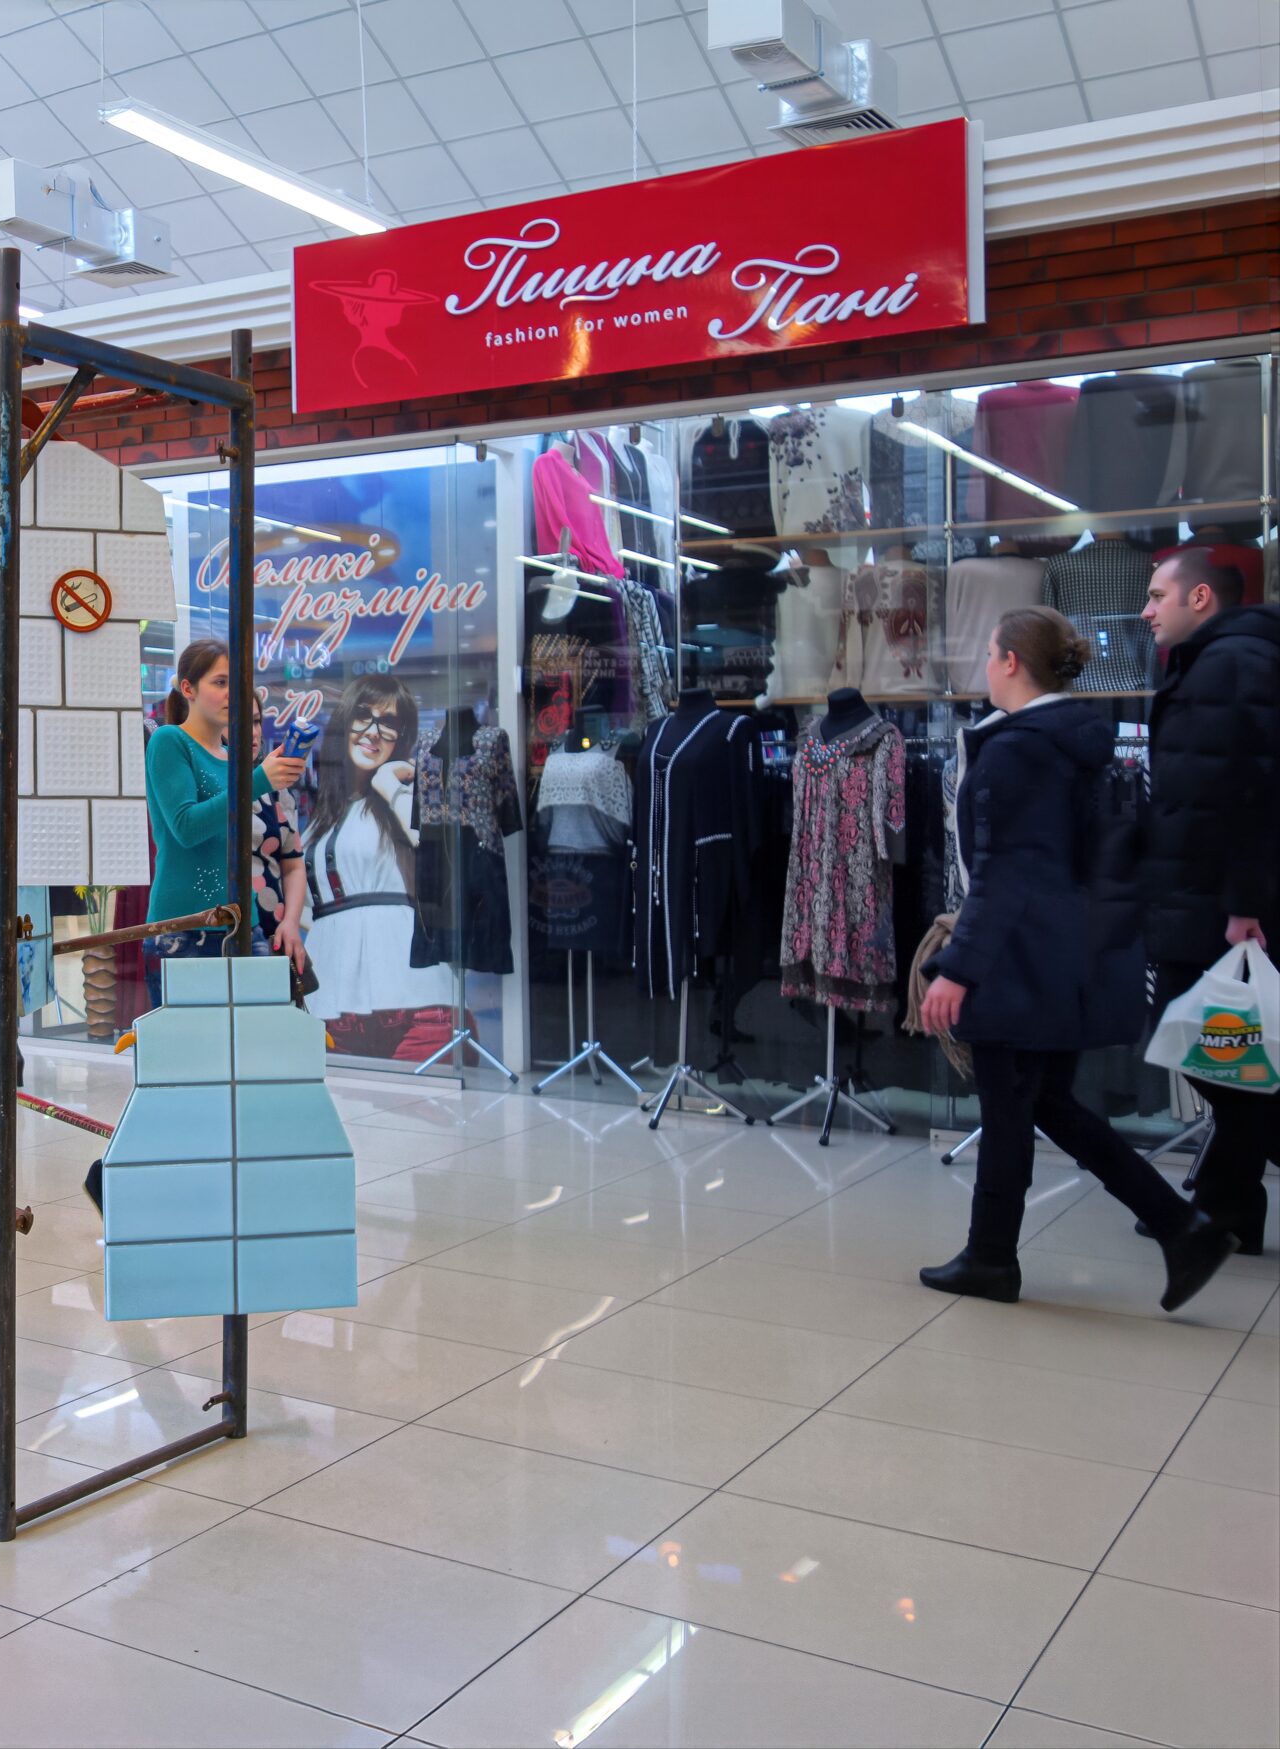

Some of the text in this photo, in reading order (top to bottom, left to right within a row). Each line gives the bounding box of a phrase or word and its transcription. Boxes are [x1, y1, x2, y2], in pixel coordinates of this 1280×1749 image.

[445, 217, 920, 340] Пишна Пані
[484, 304, 689, 349] fashion for women
[257, 567, 487, 671] розміри
